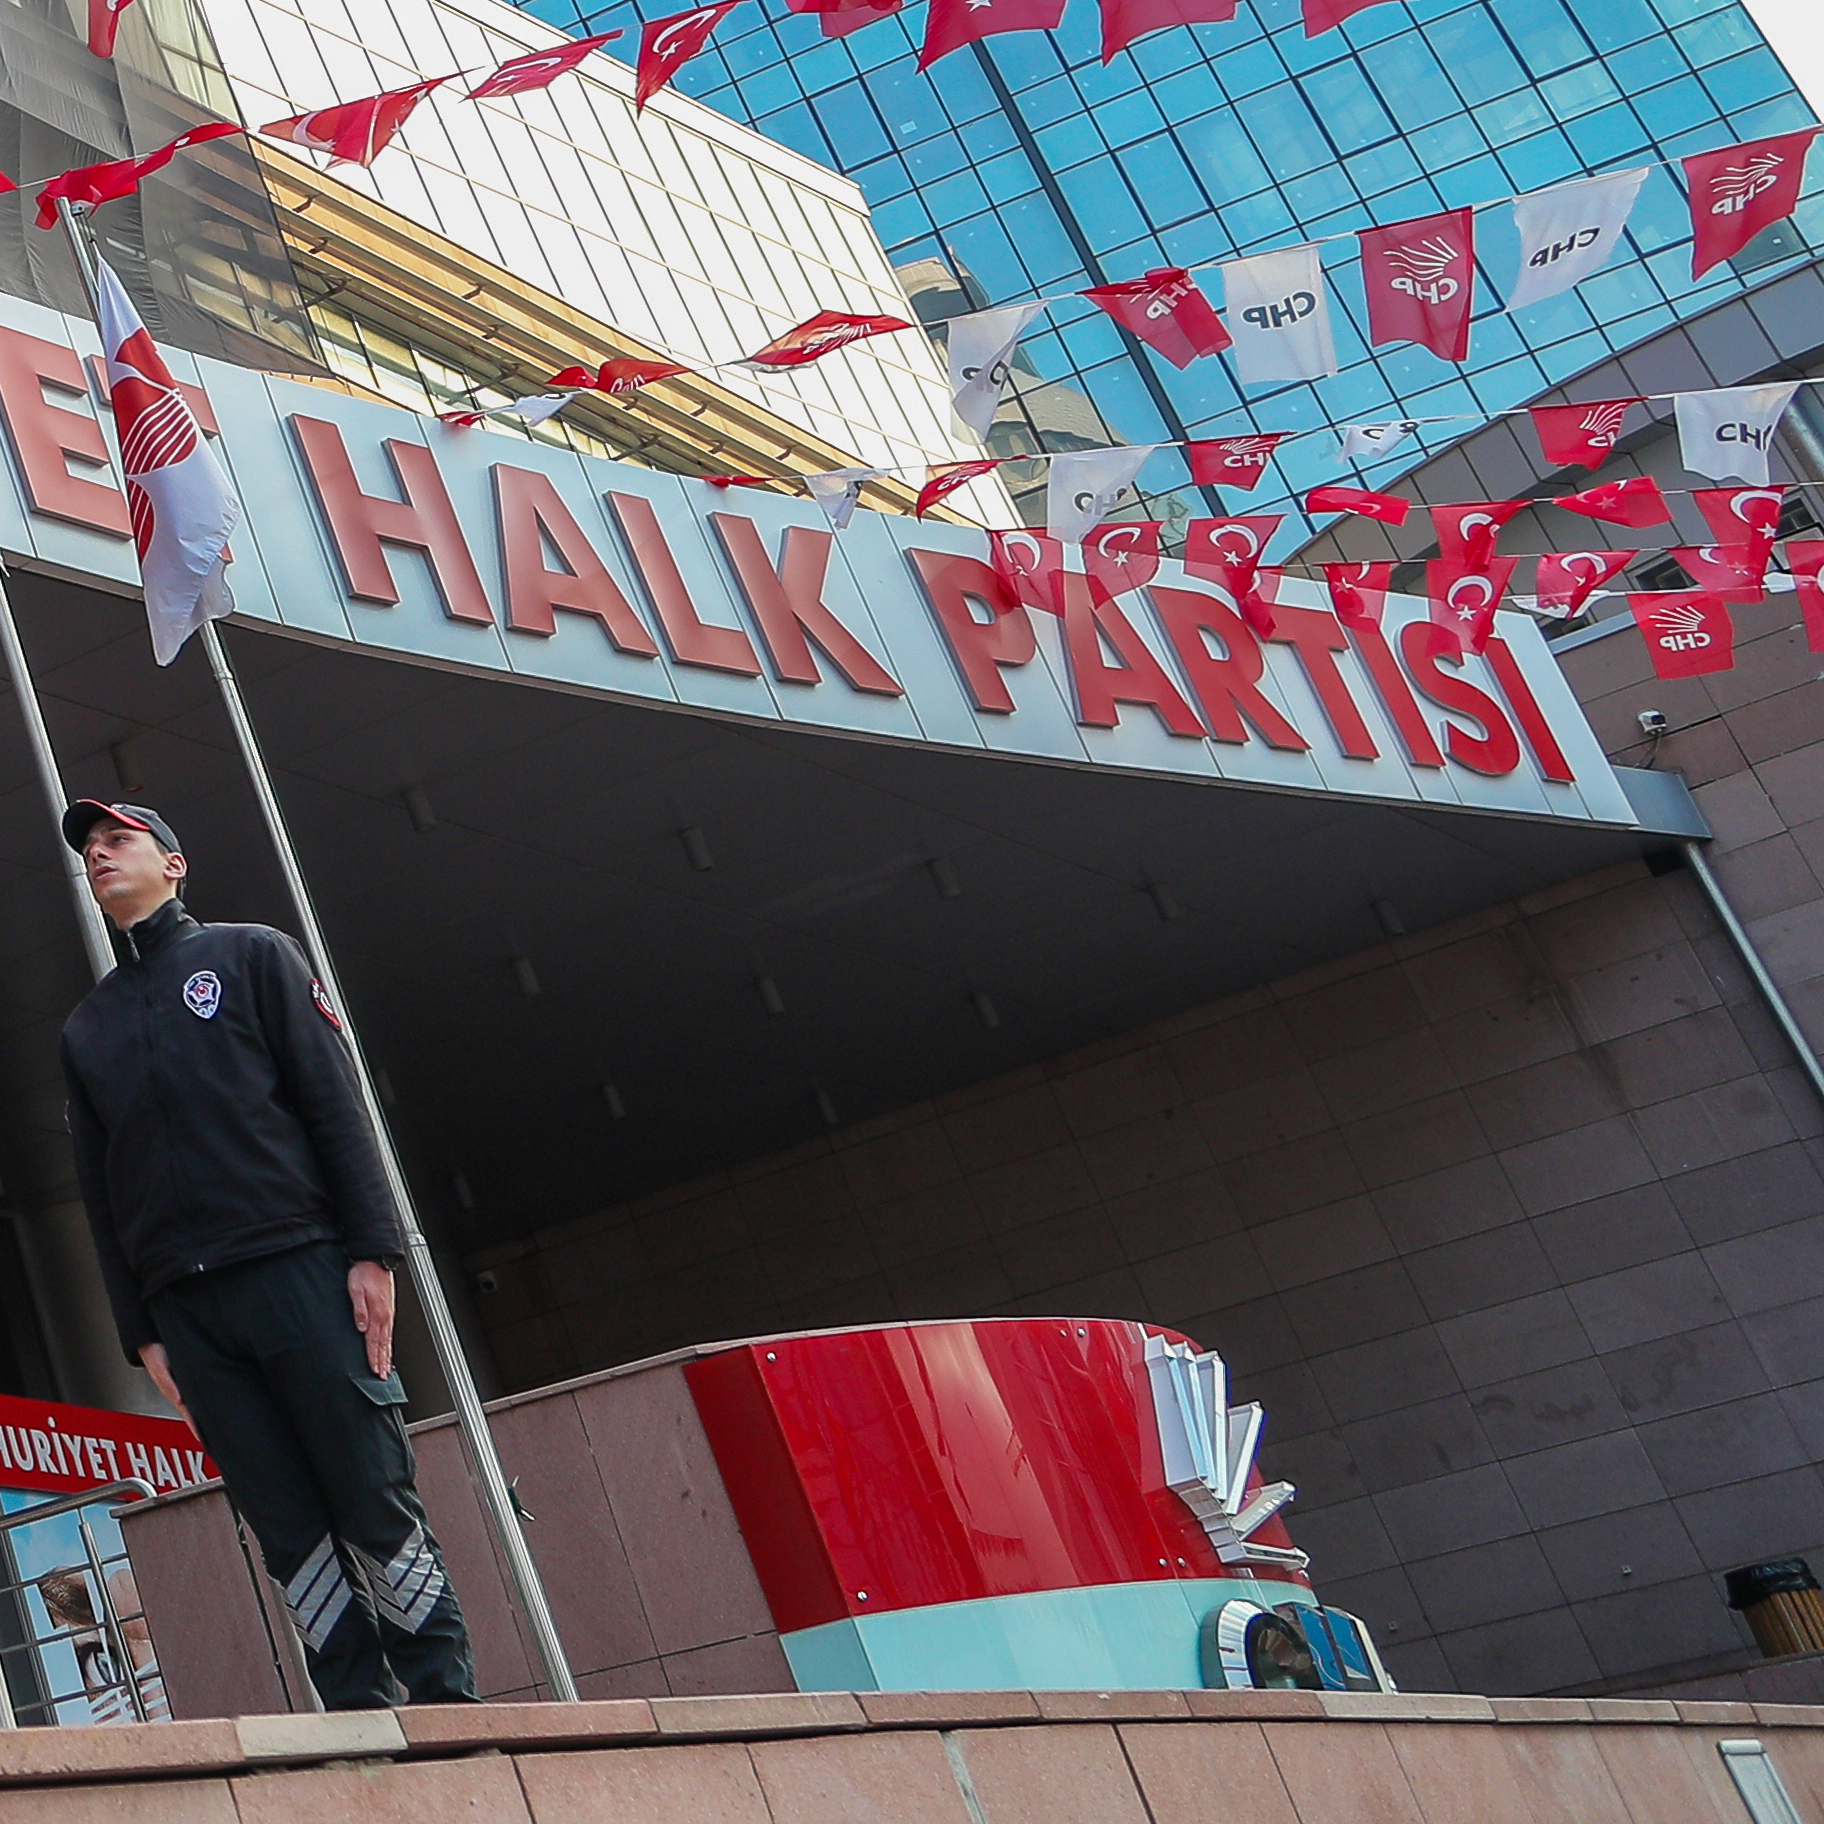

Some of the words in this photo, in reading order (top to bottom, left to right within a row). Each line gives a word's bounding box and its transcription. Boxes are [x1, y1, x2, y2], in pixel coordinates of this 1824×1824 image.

[1223, 452, 1270, 468] CH
[286, 411, 905, 699] HALK
[124, 1441, 210, 1489] HALK
